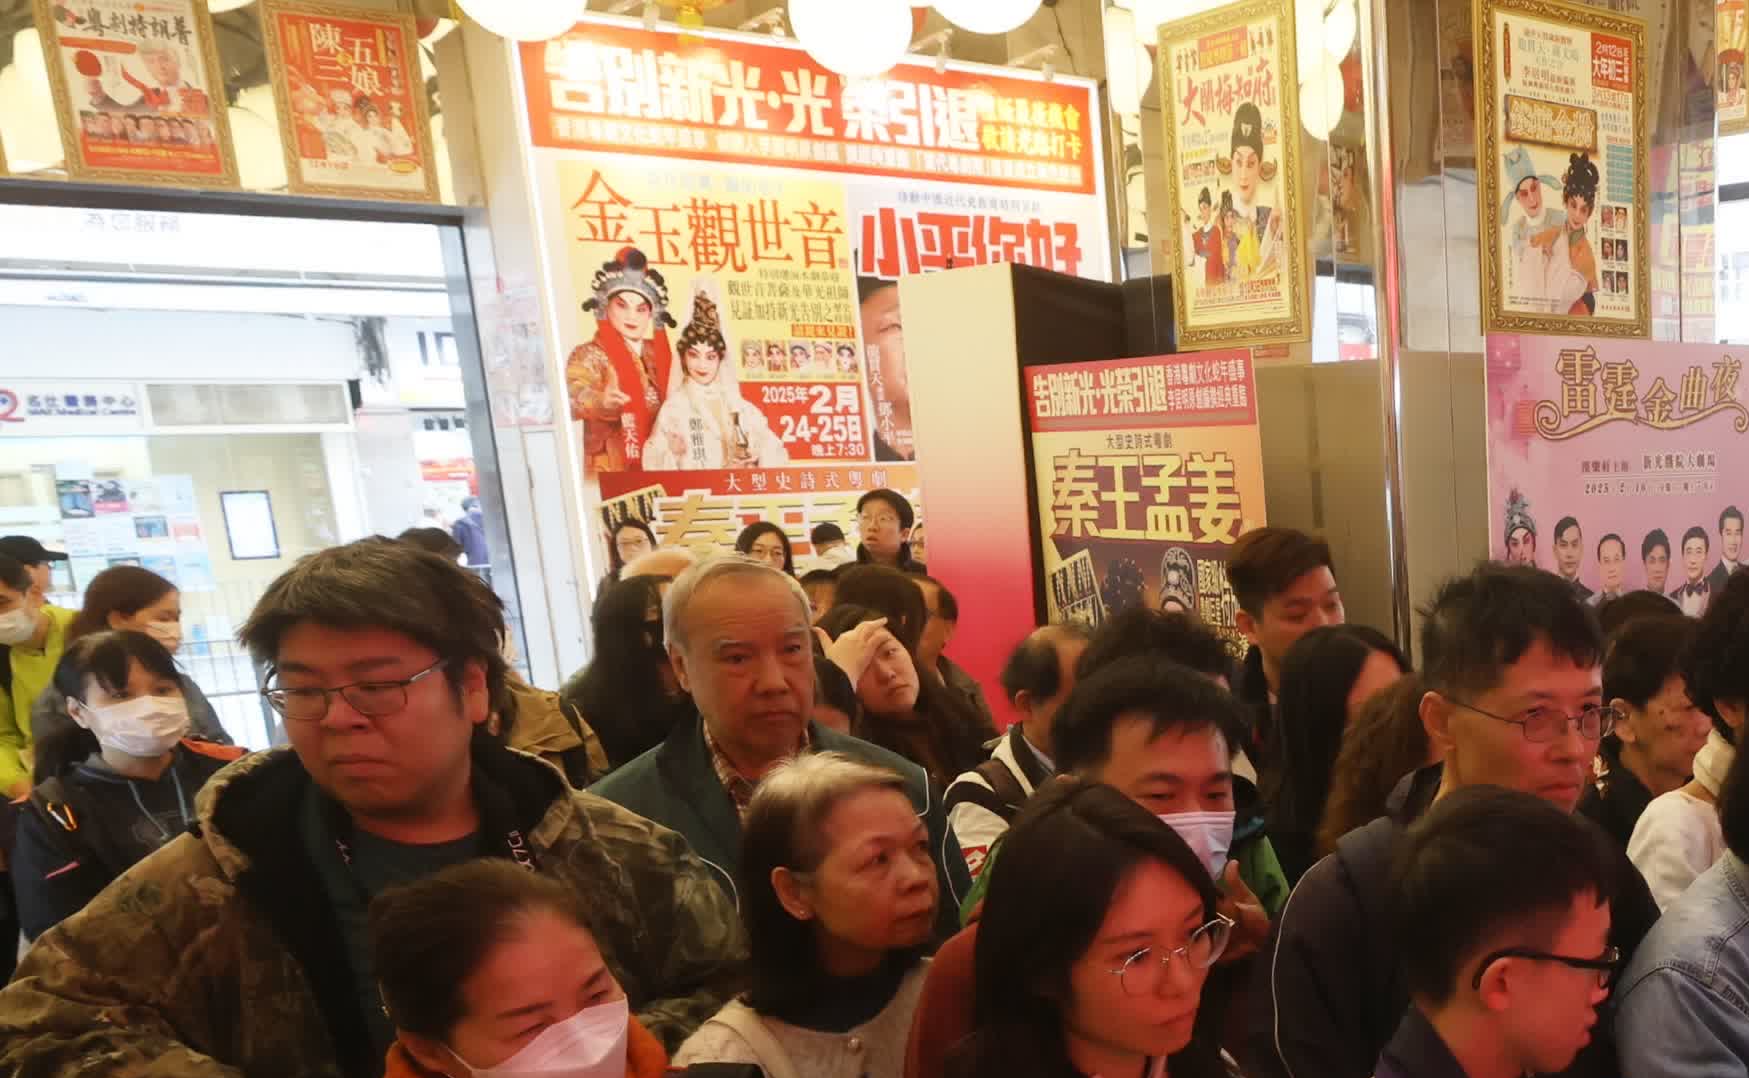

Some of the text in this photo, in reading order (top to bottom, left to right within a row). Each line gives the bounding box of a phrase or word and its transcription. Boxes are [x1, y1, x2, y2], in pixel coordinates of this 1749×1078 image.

[571, 170, 846, 274] 金玉觀世音
[861, 207, 1084, 277] 小平你好
[762, 385, 858, 414] 2025年 2月
[1033, 364, 1168, 417] 告別新光·光榮引退
[1555, 345, 1743, 425] 雷霆金曲夜
[780, 415, 862, 443] 24-25日
[724, 470, 888, 493] 大型史詩式粵劇
[1051, 449, 1243, 546] 秦王孟姜
